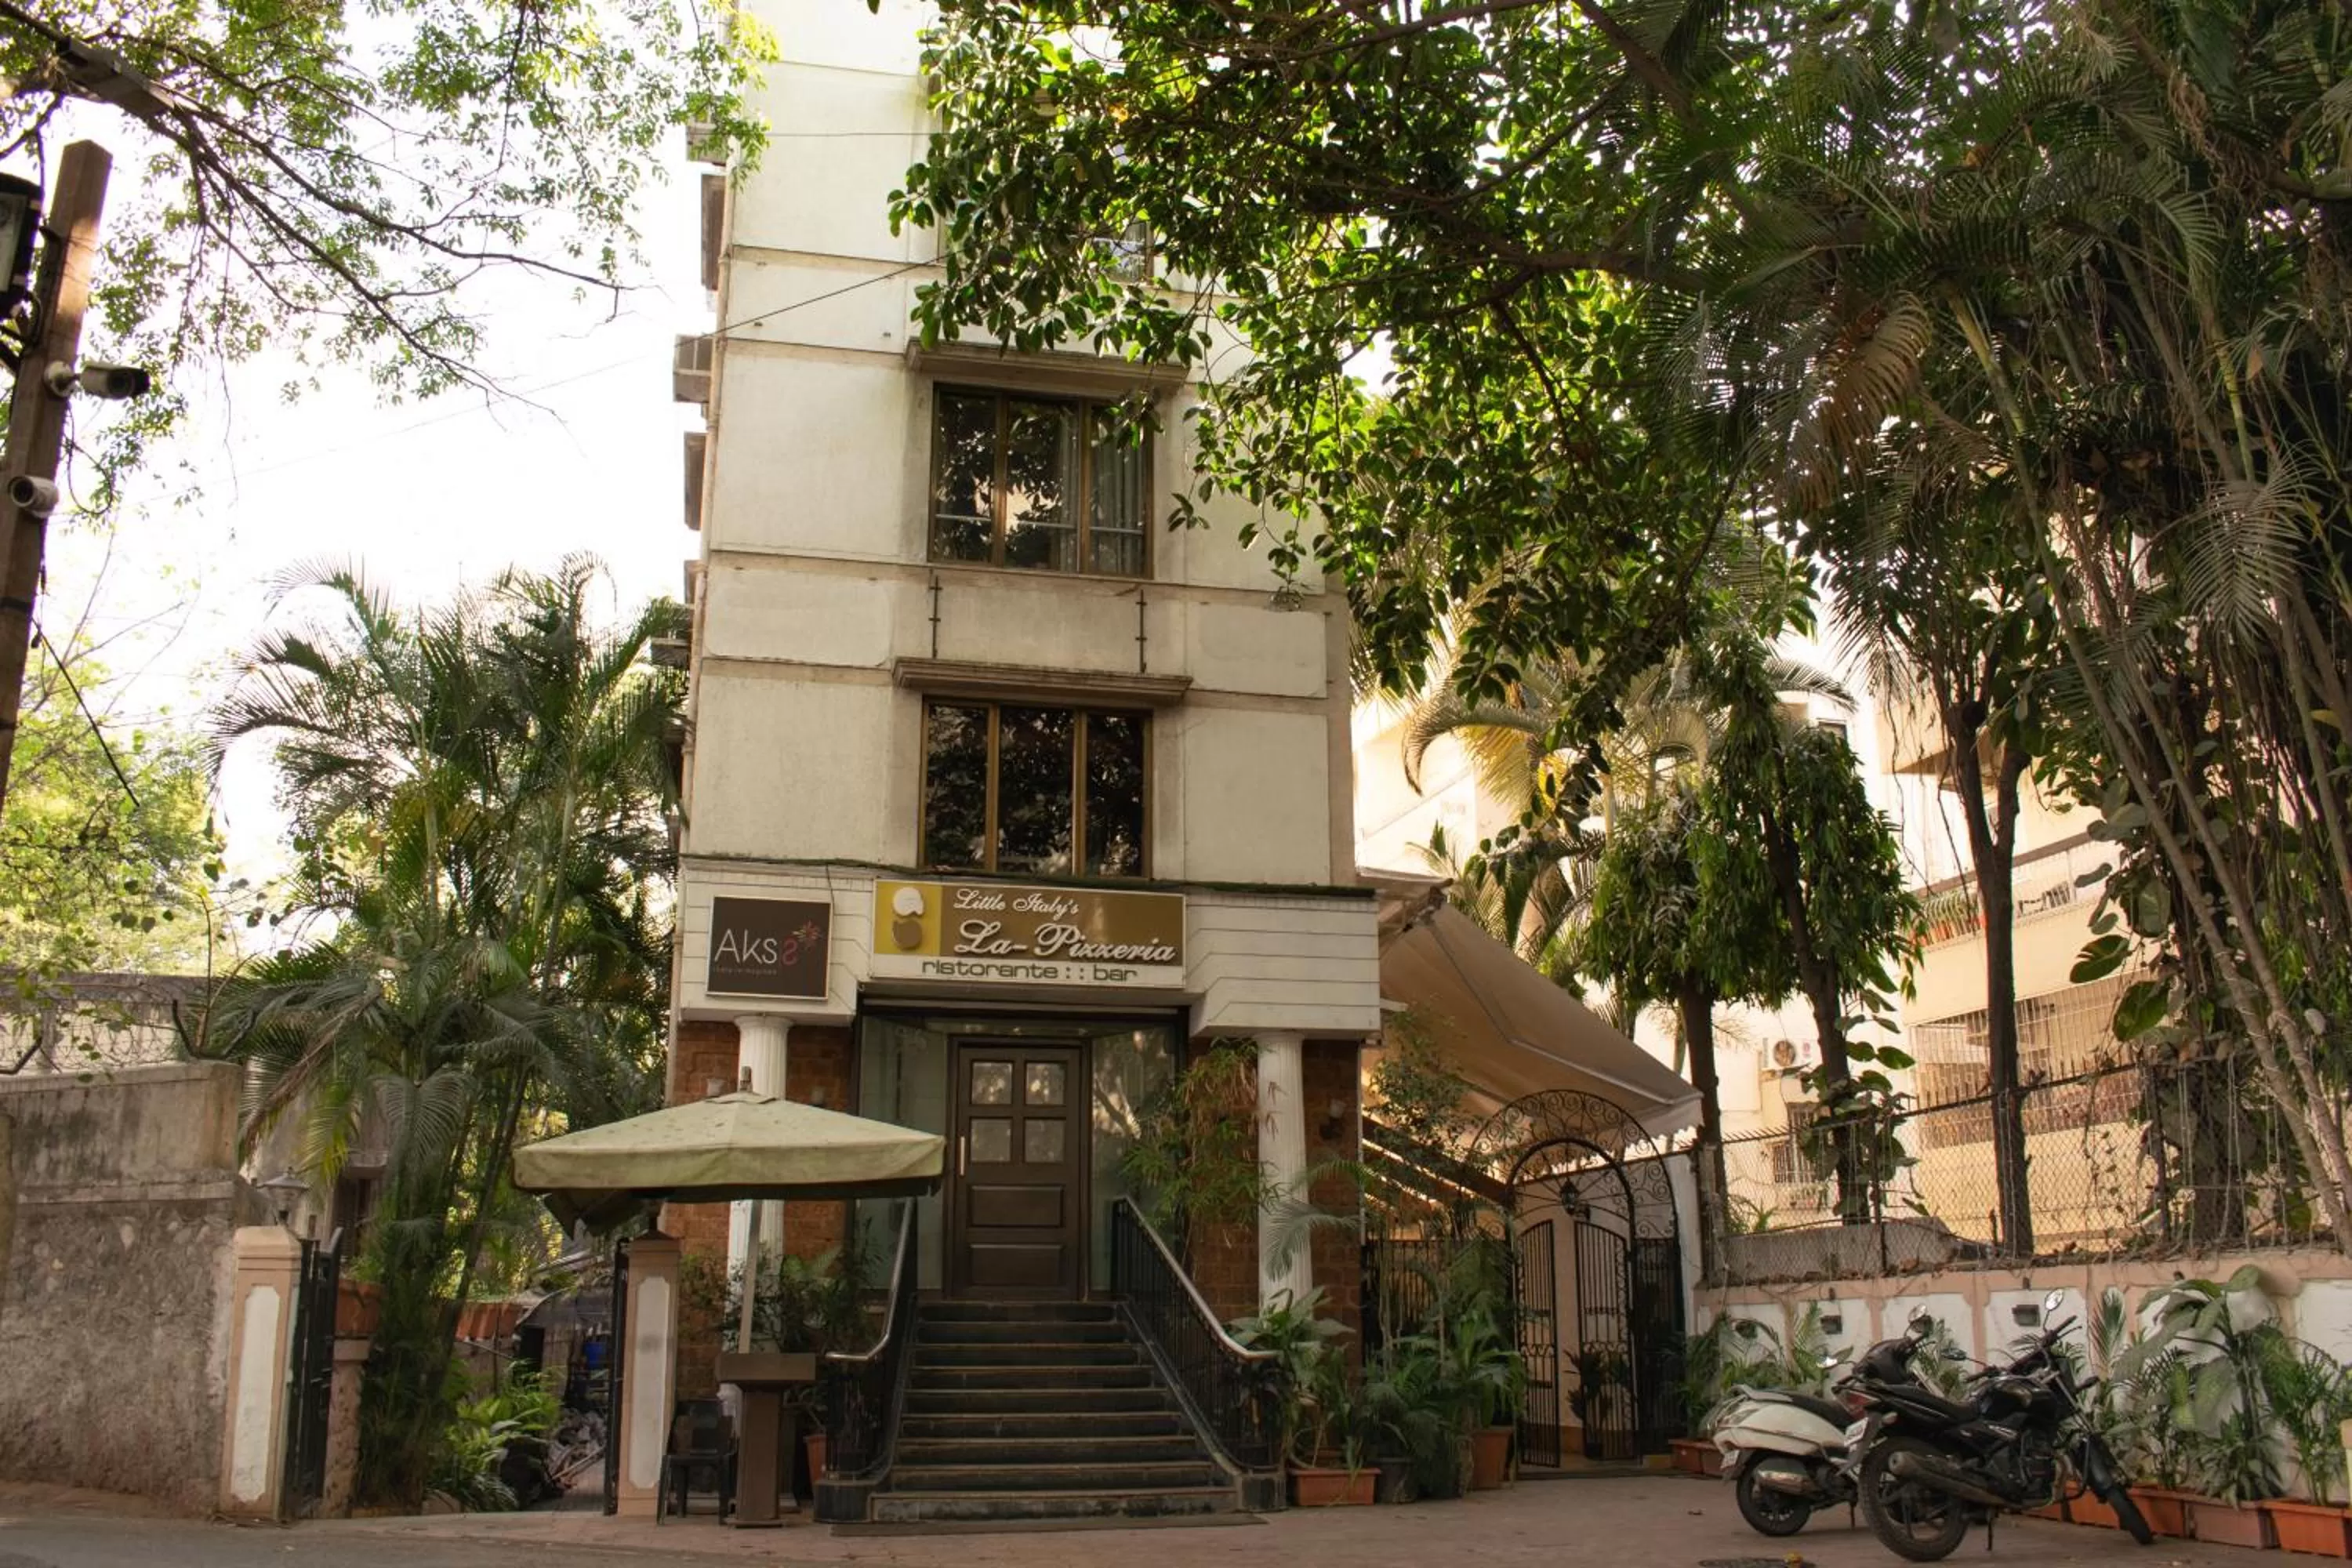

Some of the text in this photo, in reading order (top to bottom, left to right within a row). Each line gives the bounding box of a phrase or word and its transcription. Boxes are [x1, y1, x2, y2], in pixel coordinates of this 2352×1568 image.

[953, 888, 1080, 920] Little Italy's
[1033, 923, 1176, 962] Pizzeria
[922, 960, 1058, 979] ristorante
[1093, 964, 1138, 982] bar
